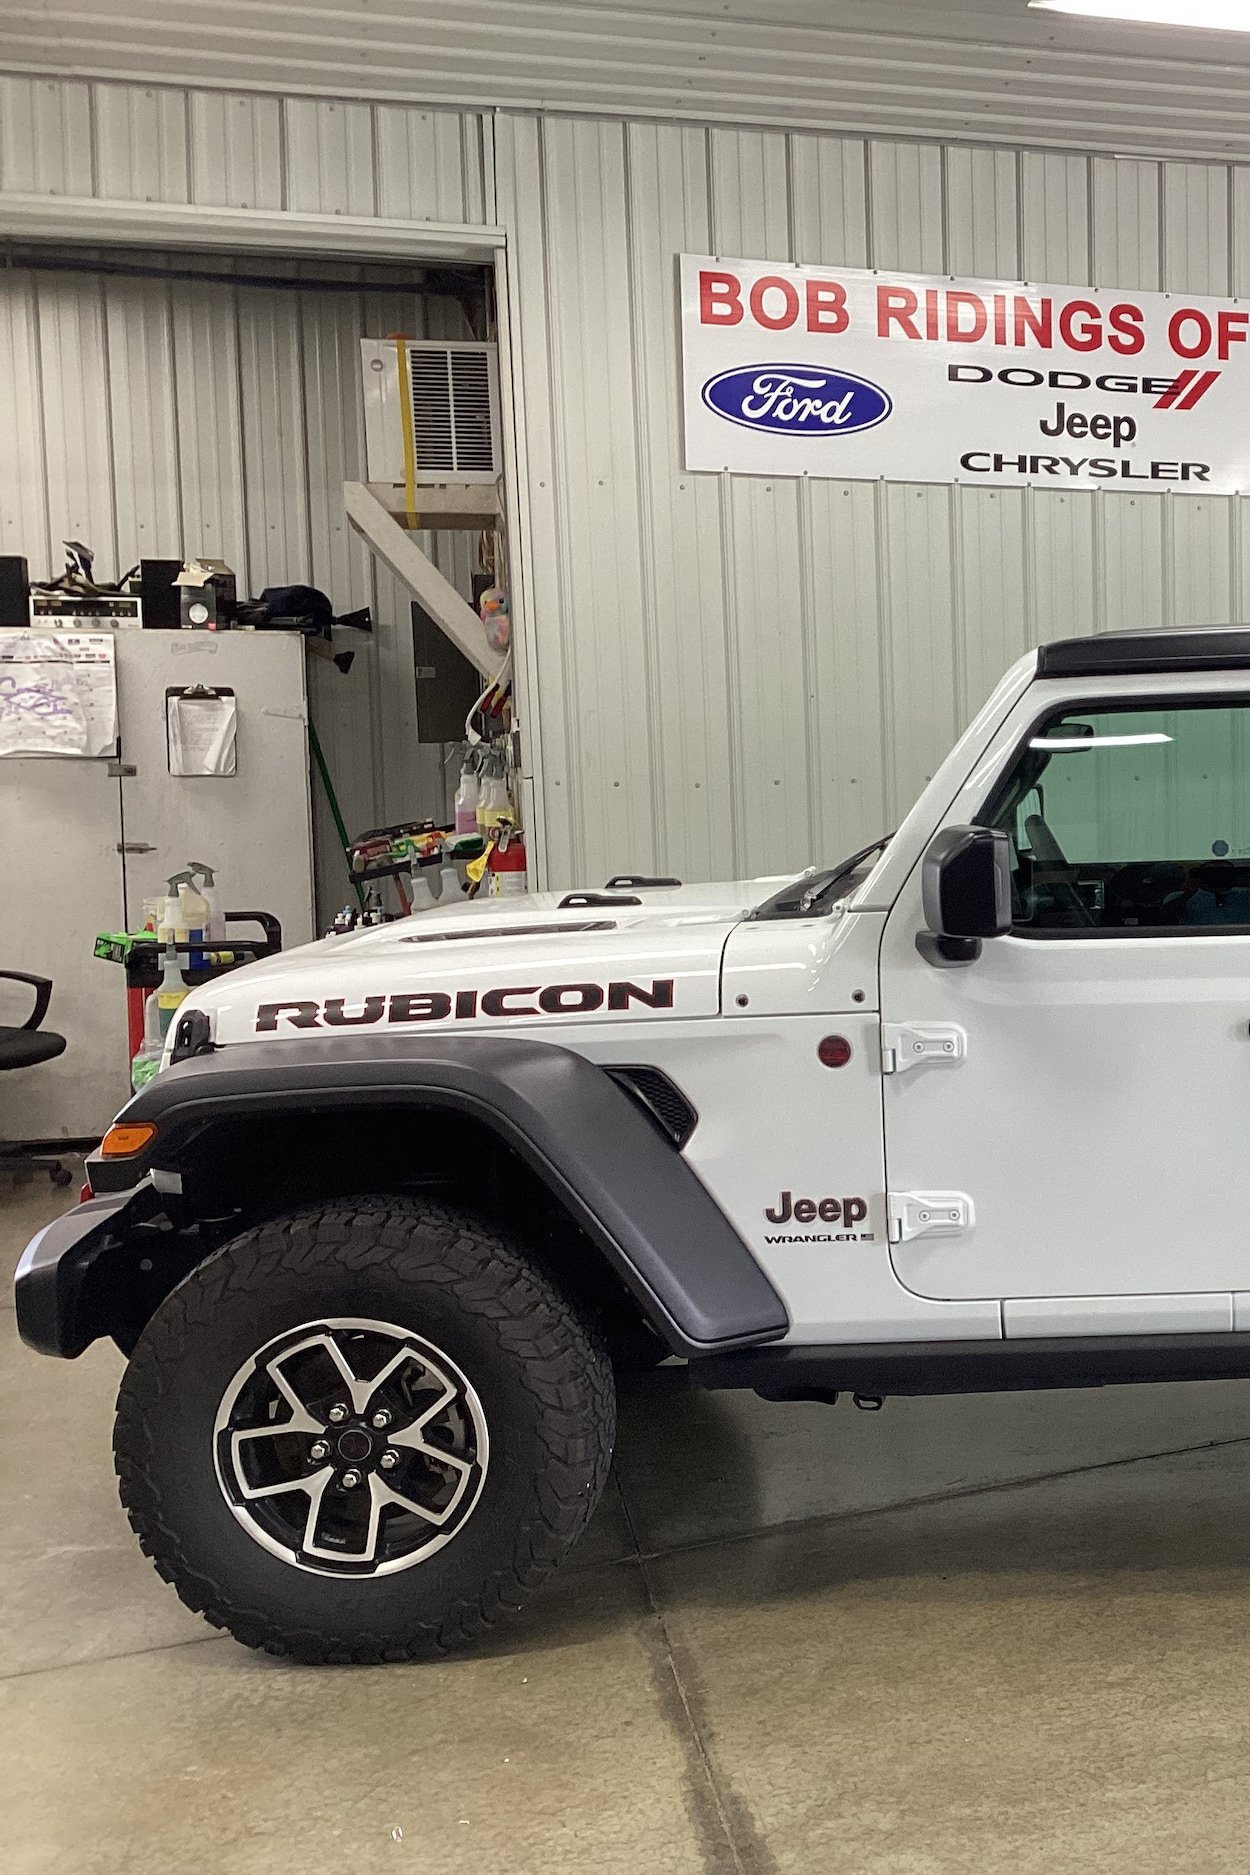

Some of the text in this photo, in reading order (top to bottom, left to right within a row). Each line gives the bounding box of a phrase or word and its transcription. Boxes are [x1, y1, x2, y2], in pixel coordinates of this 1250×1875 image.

[699, 270, 851, 334] BOB
[877, 285, 1145, 356] RIDINGS
[1168, 308, 1249, 360] OF
[741, 373, 855, 424] Ford
[948, 364, 1180, 396] DODGE
[1039, 402, 1137, 448] Jeep
[960, 452, 1211, 482] CHRYSLER
[255, 978, 676, 1033] RUBICON
[765, 1191, 868, 1228] Jeep
[763, 1233, 858, 1245] WRANGLER
